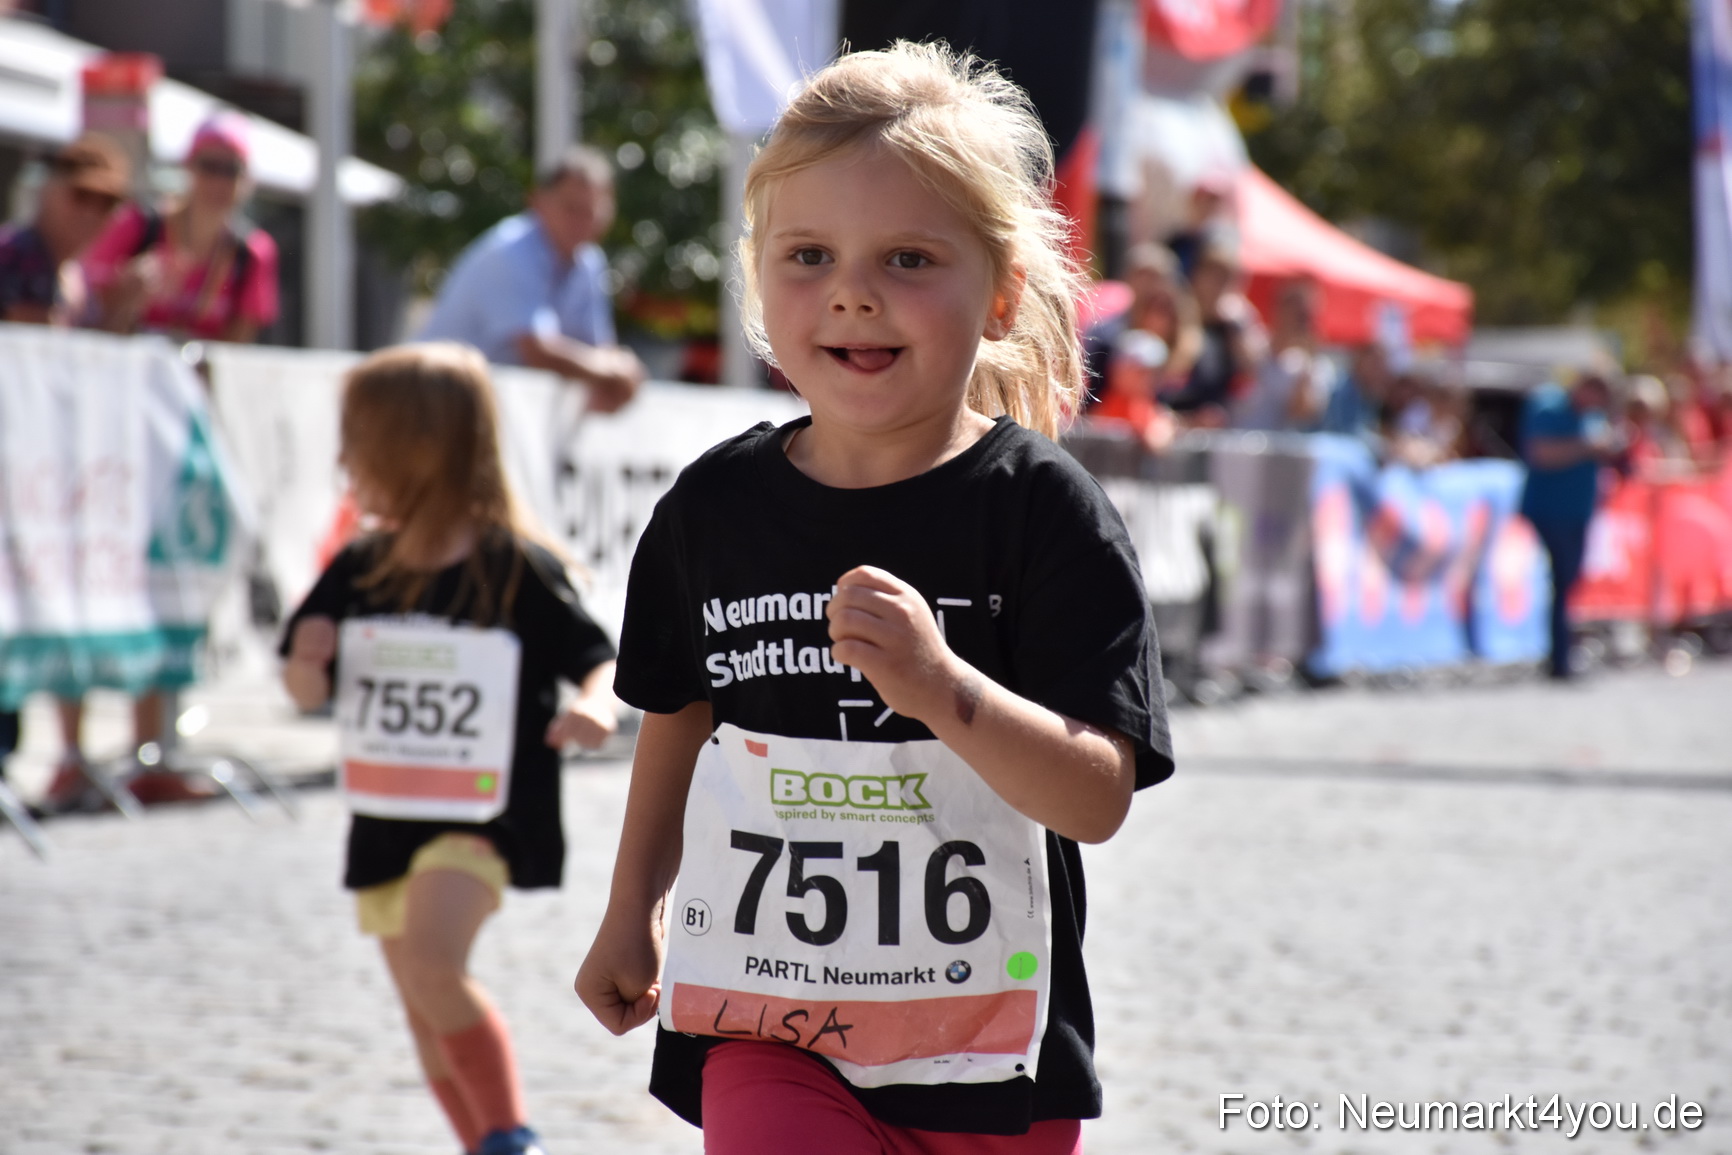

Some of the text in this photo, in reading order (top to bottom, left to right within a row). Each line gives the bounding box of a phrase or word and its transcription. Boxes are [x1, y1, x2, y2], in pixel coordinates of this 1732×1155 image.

[357, 677, 483, 739] 7552
[771, 768, 932, 810] BOCK
[821, 809, 836, 821] by
[840, 811, 876, 822] smart
[880, 812, 935, 825] concepts
[730, 829, 991, 946] 7516
[686, 907, 705, 928] B1
[745, 956, 816, 984] PARTL
[823, 966, 936, 985] Neumarkt
[713, 999, 853, 1049] LISA
